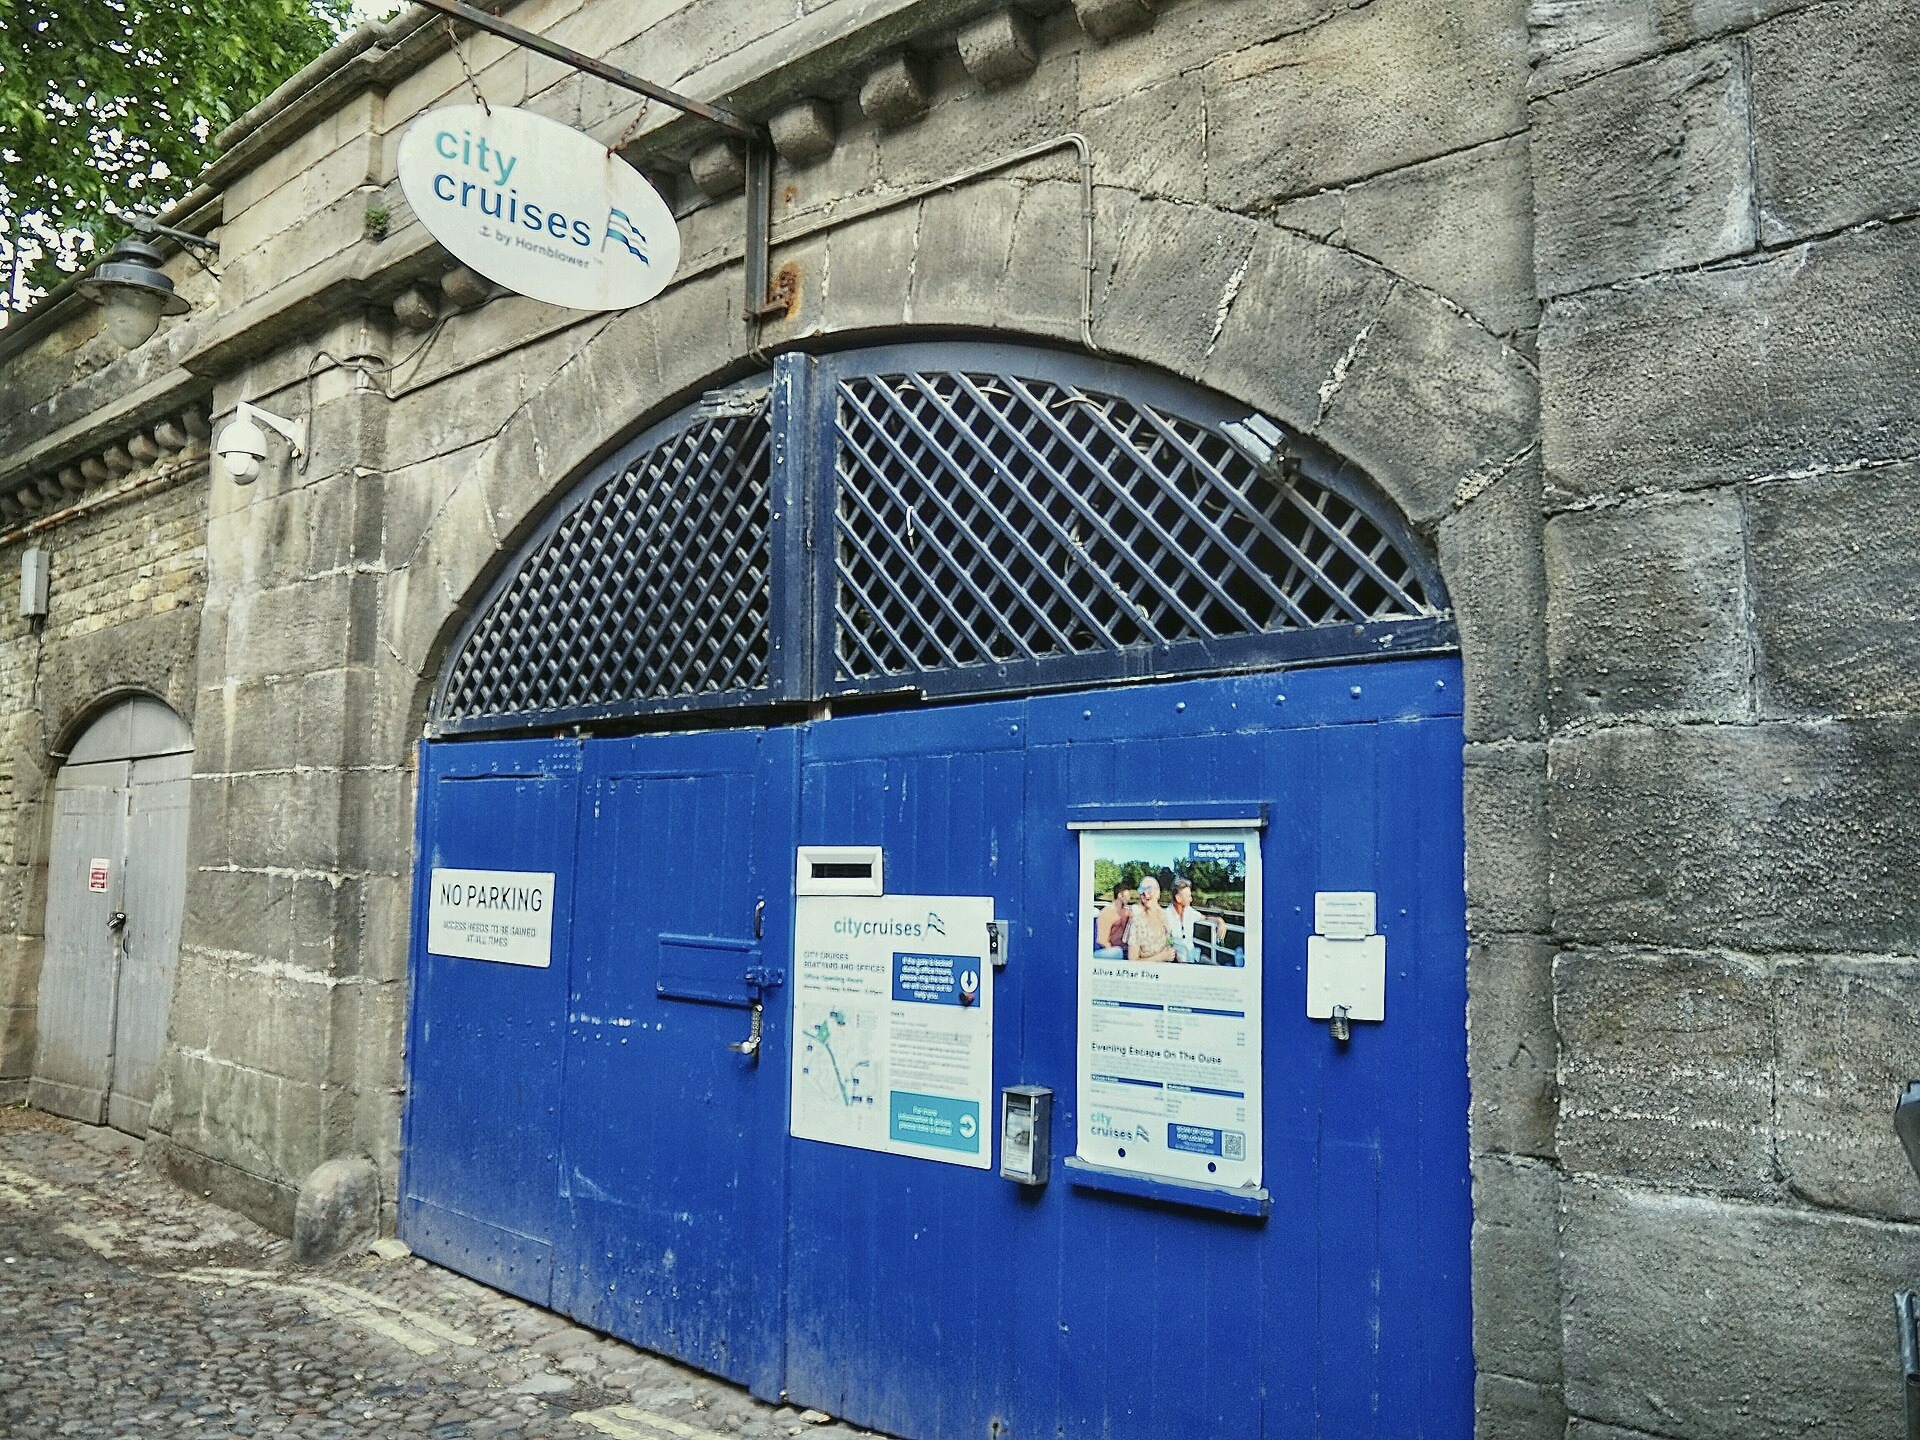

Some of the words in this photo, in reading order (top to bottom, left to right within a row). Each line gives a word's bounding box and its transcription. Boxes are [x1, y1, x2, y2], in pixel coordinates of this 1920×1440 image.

[434, 130, 517, 186] city
[433, 173, 592, 247] cruises
[496, 230, 512, 245] by
[516, 236, 590, 269] Hornblower
[440, 883, 462, 906] NO
[467, 885, 542, 912] PARKING
[443, 920, 467, 931] ACCESS
[468, 921, 489, 933] NEEDS
[491, 923, 499, 933] TO
[501, 925, 509, 935] BE
[511, 926, 536, 938] GAINED
[834, 917, 922, 939] citycruises
[466, 934, 474, 943] AT
[476, 935, 486, 945] ALL
[488, 936, 508, 947] TIMES
[803, 951, 818, 959] CITY
[820, 952, 849, 960] CRUISES
[841, 963, 854, 972] AND
[857, 964, 886, 973] OFFICES
[1115, 969, 1139, 978] After
[900, 973, 918, 982] please
[1091, 1043, 1126, 1056] Evening
[1129, 1046, 1161, 1058] Escape
[1163, 1050, 1176, 1060] On
[1179, 1051, 1195, 1061] The
[1198, 1053, 1222, 1065] Ouse
[1090, 1111, 1112, 1127] city
[1090, 1125, 1133, 1142] cruises
